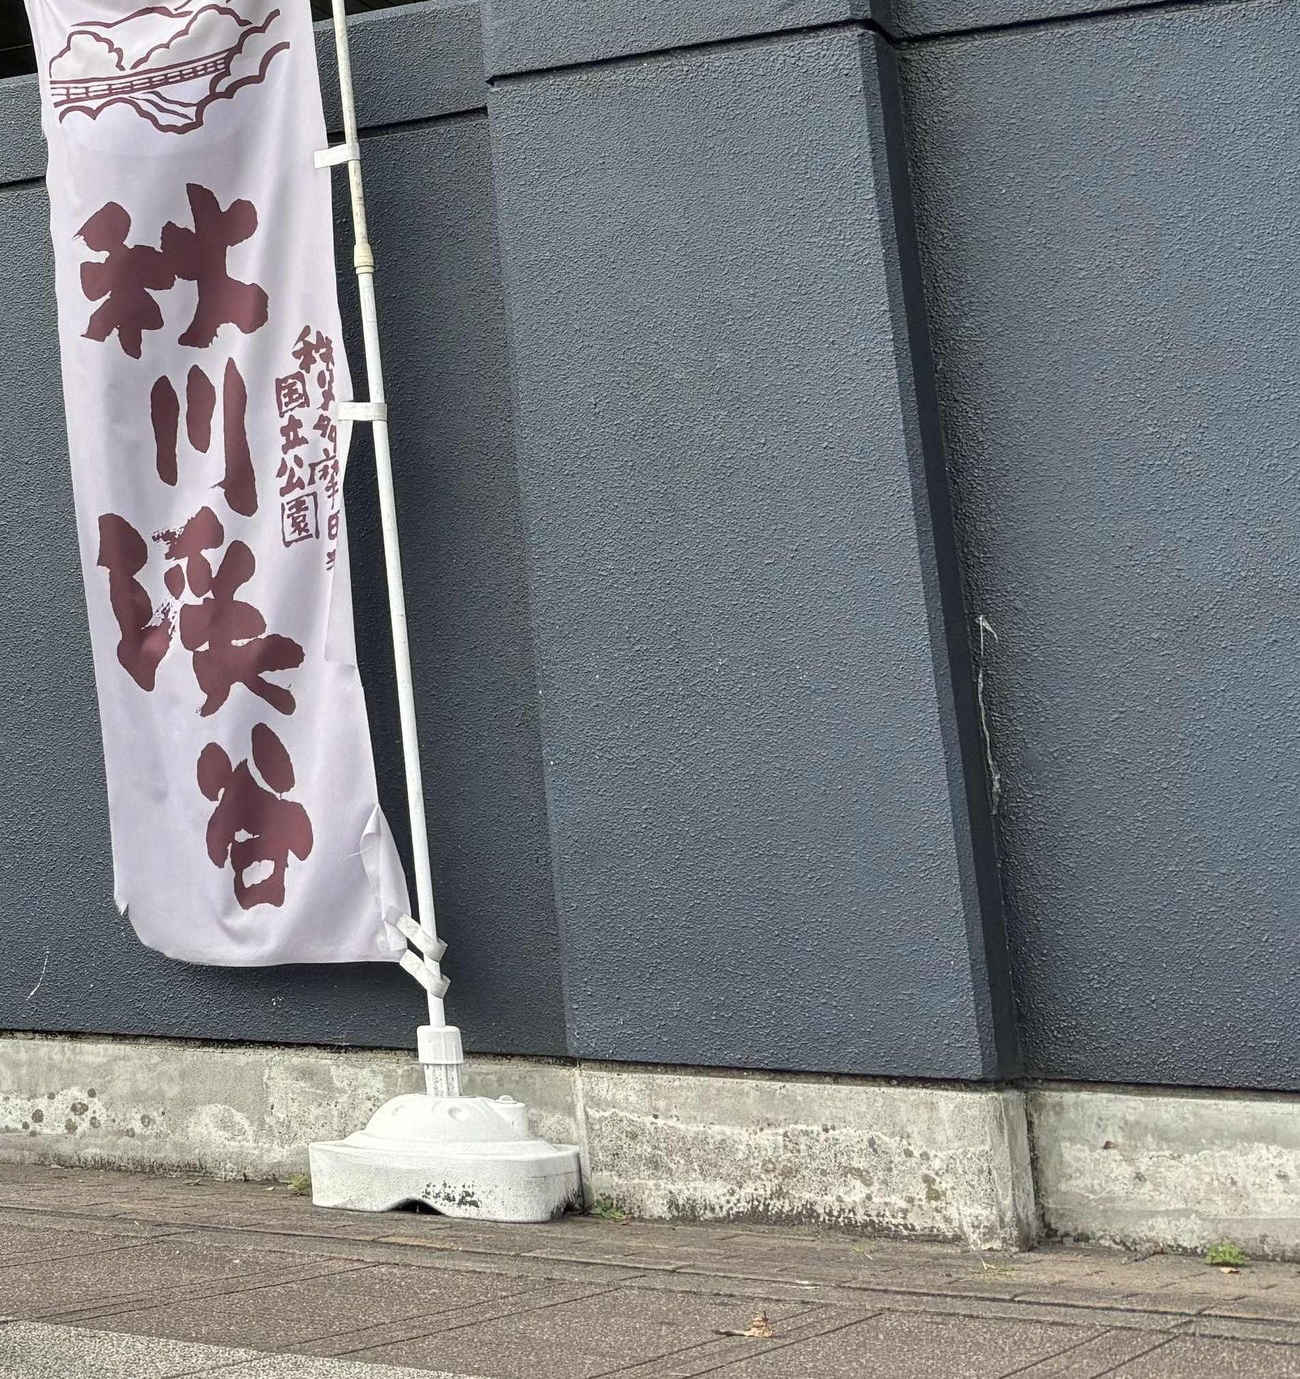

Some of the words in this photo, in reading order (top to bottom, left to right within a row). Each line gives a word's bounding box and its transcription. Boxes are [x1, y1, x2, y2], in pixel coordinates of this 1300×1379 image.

[74, 182, 313, 911] 秋川渓谷
[273, 370, 320, 548] 国立公園
